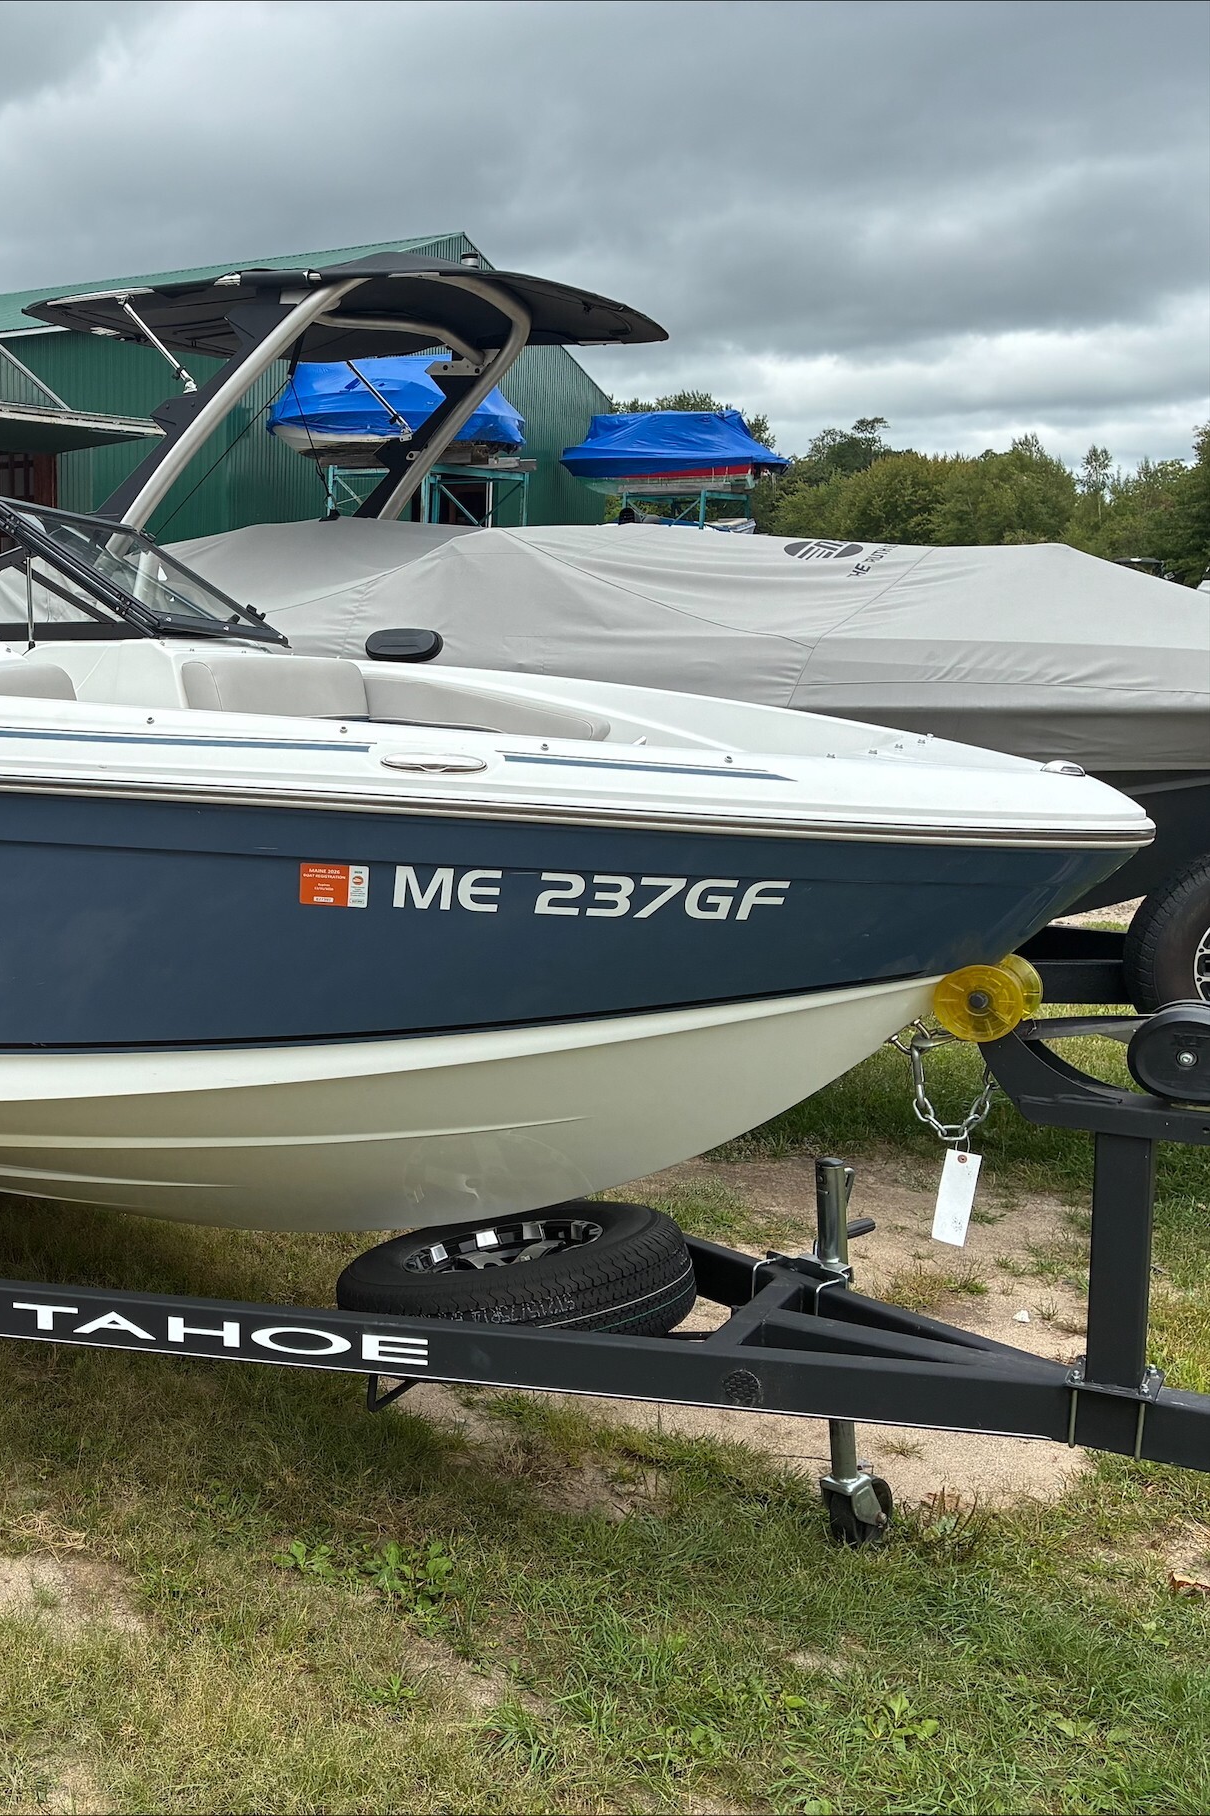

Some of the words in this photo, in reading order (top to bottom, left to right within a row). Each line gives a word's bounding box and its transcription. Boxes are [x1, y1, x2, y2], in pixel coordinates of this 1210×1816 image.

[392, 865, 503, 913] ME
[534, 872, 792, 921] 237GF
[12, 1302, 430, 1367] TAHOE
